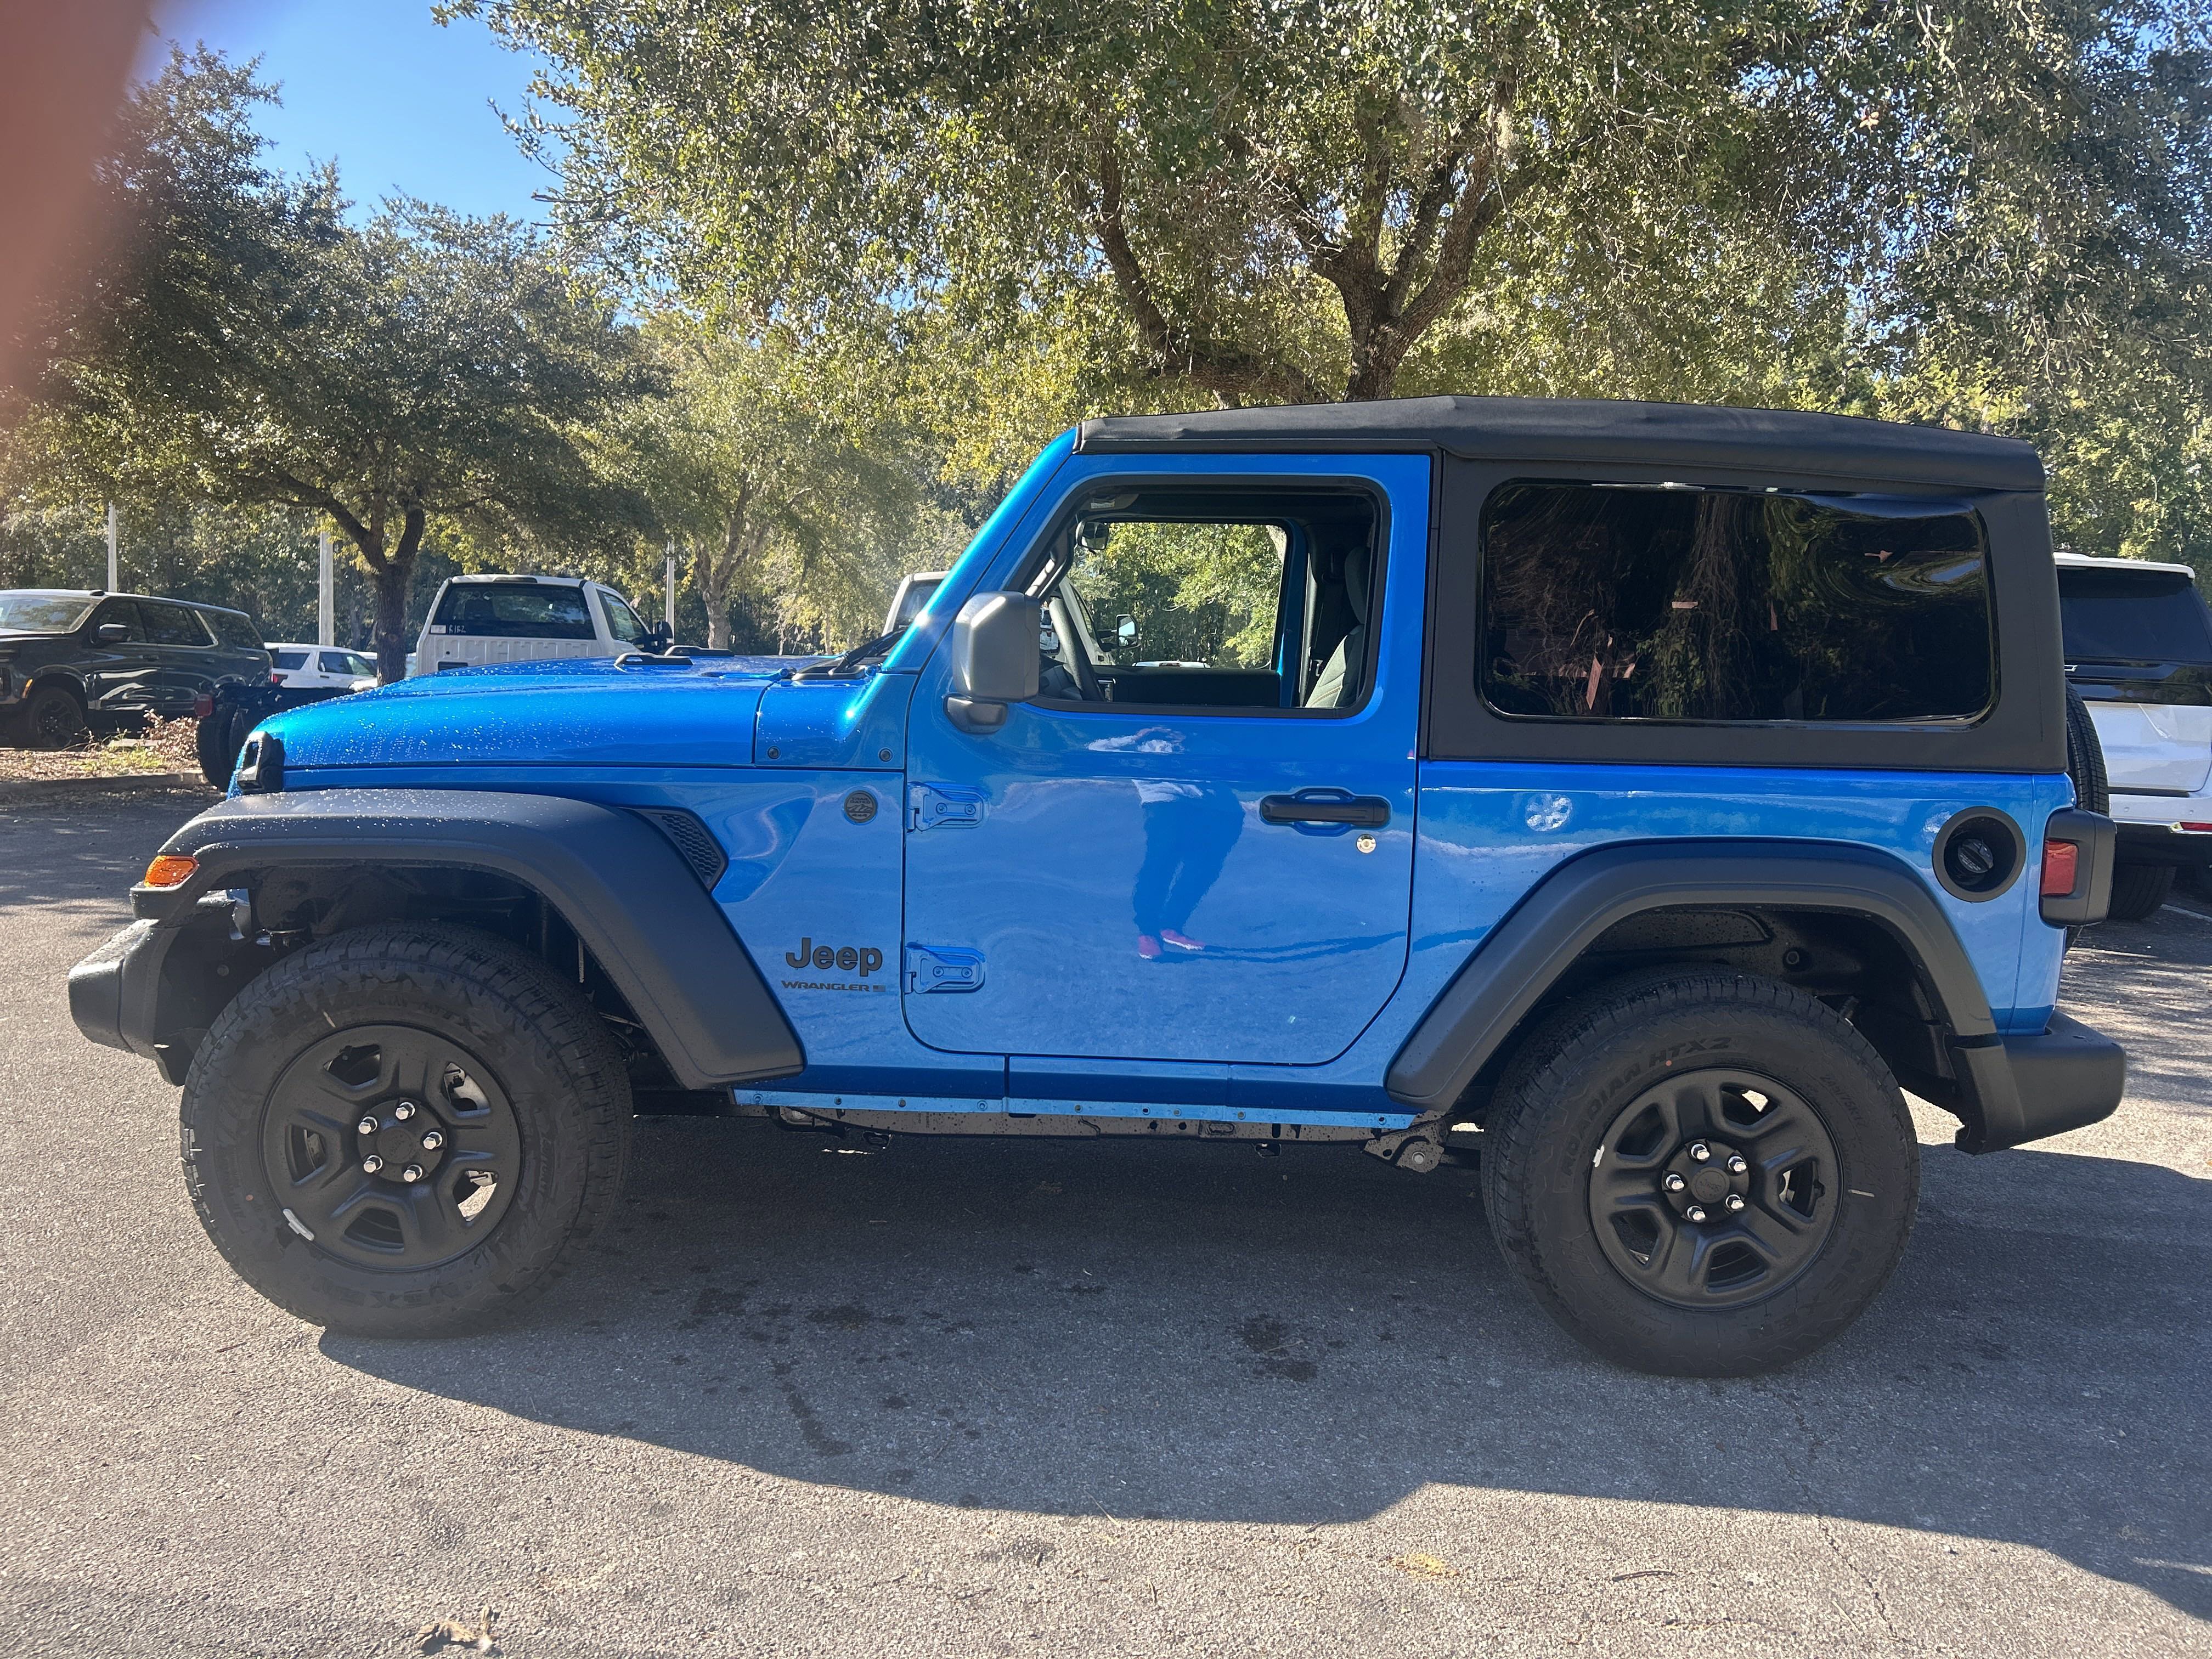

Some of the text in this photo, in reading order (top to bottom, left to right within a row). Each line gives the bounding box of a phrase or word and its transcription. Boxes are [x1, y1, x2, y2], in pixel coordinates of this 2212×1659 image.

[786, 937, 883, 977] Jeep
[781, 980, 870, 992] WRANGLER
[1561, 1037, 1733, 1176] ROADIAN HTX2
